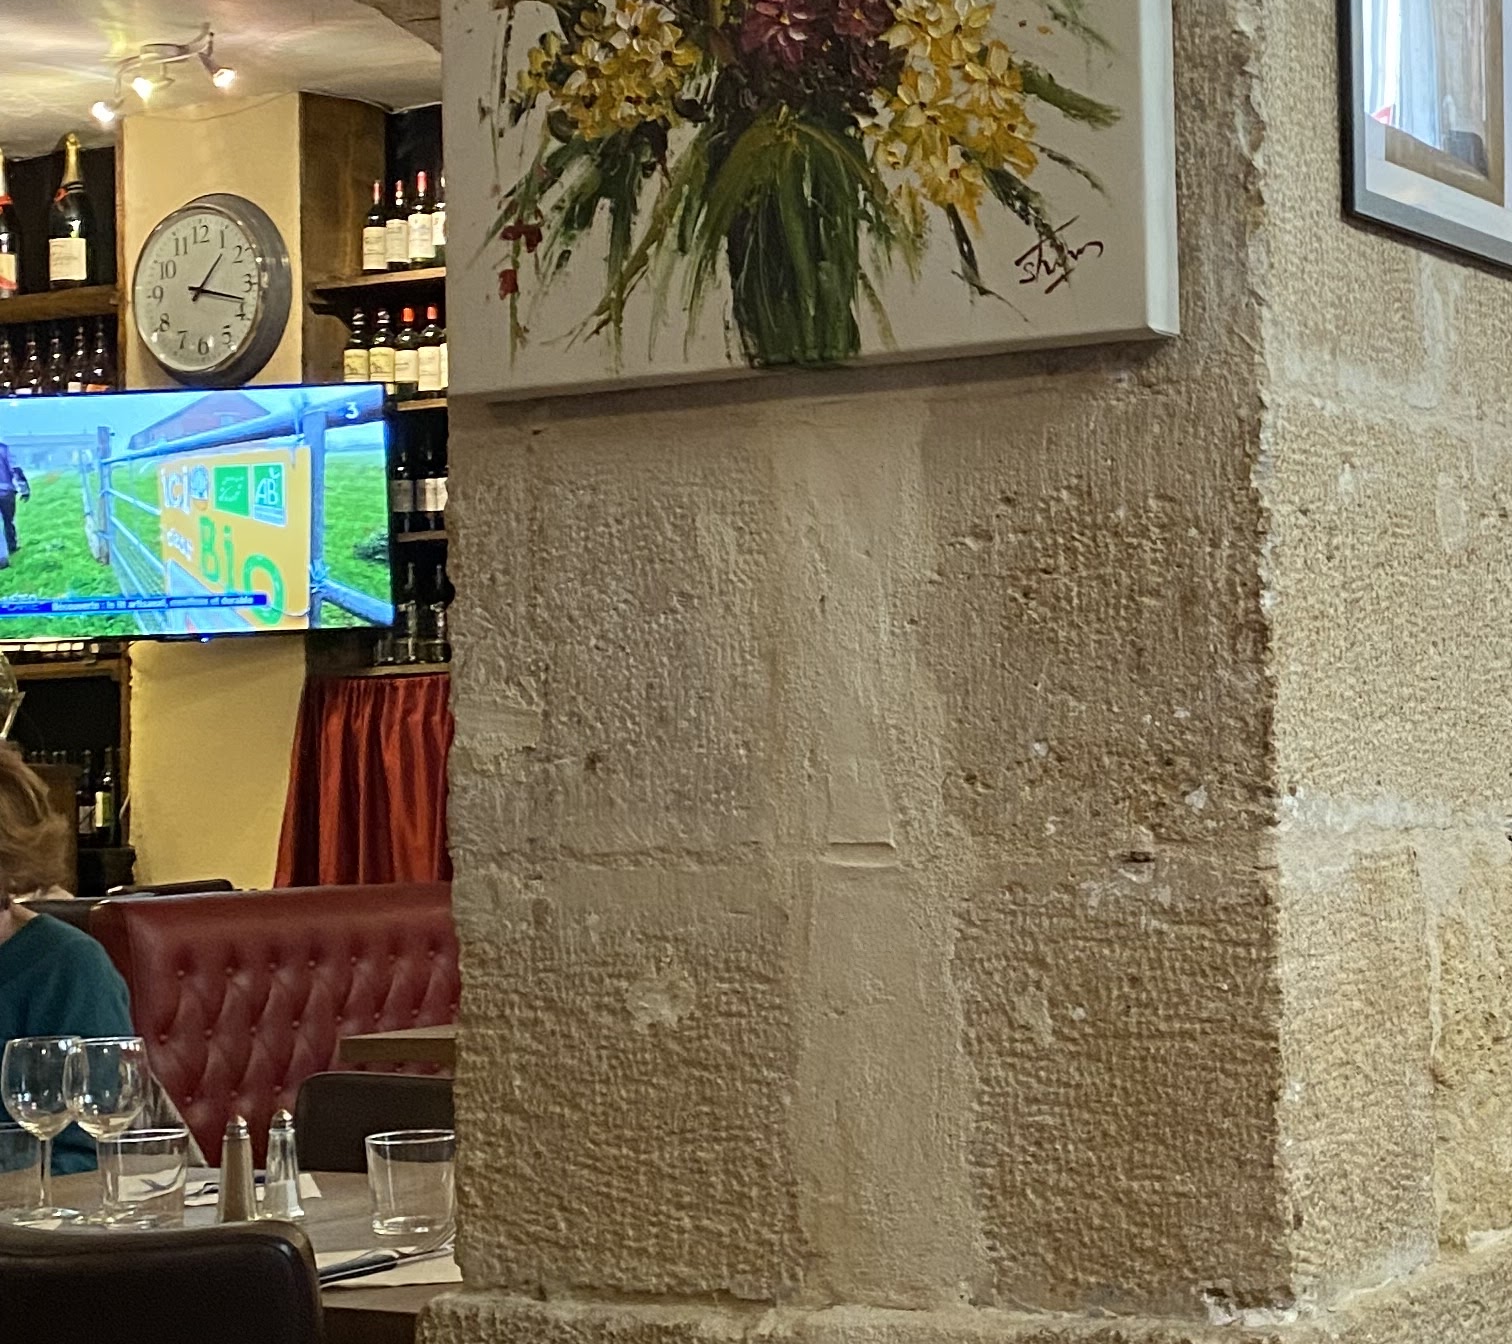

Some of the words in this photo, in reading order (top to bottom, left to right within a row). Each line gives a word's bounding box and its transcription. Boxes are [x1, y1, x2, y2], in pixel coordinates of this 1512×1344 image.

[192, 224, 210, 245] 12
[219, 229, 226, 249] 1
[174, 236, 188, 256] 11
[232, 244, 243, 263] 2
[159, 260, 177, 280] 10
[242, 273, 253, 293] 3
[152, 285, 164, 306] 9
[235, 302, 247, 321] 4
[159, 313, 171, 332] 8
[177, 330, 188, 350] 7
[222, 324, 232, 345] 5
[197, 337, 210, 356] 6
[345, 401, 360, 420] 3
[255, 476, 281, 506] AB
